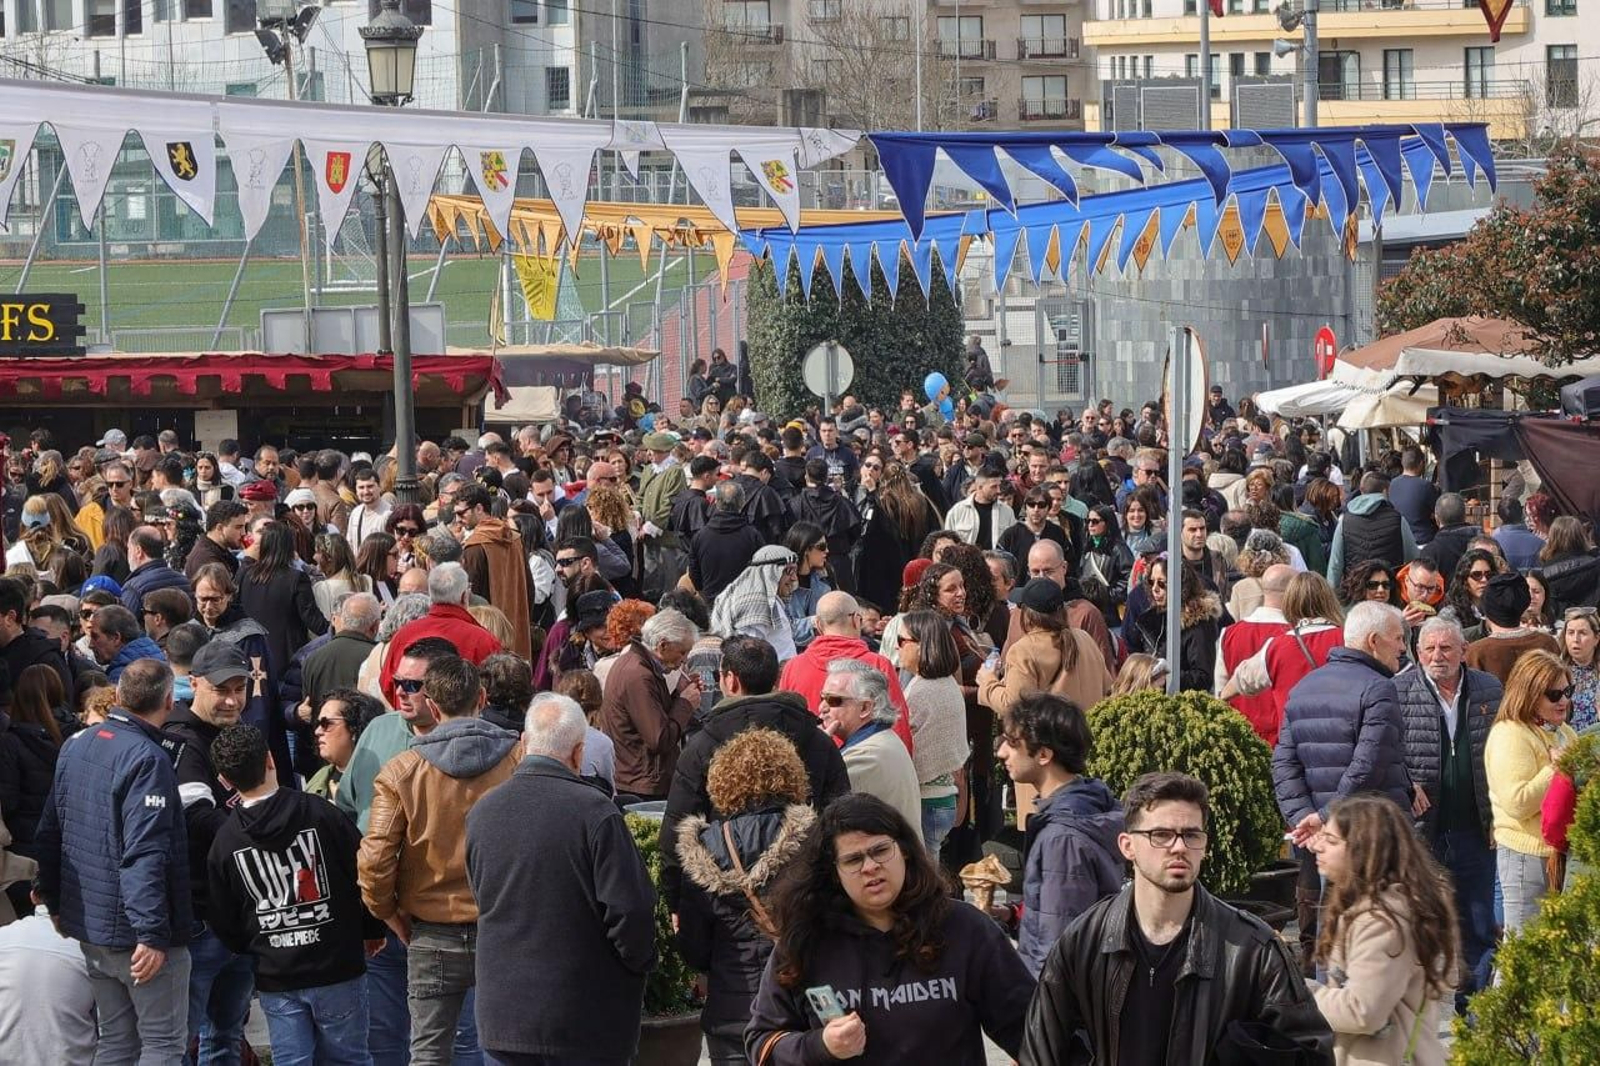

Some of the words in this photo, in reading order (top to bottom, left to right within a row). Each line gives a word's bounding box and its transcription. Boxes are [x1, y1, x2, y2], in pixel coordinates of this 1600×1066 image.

[145, 795, 166, 808] HH
[294, 928, 320, 946] PIECE
[870, 977, 959, 1012] MAIDEN
